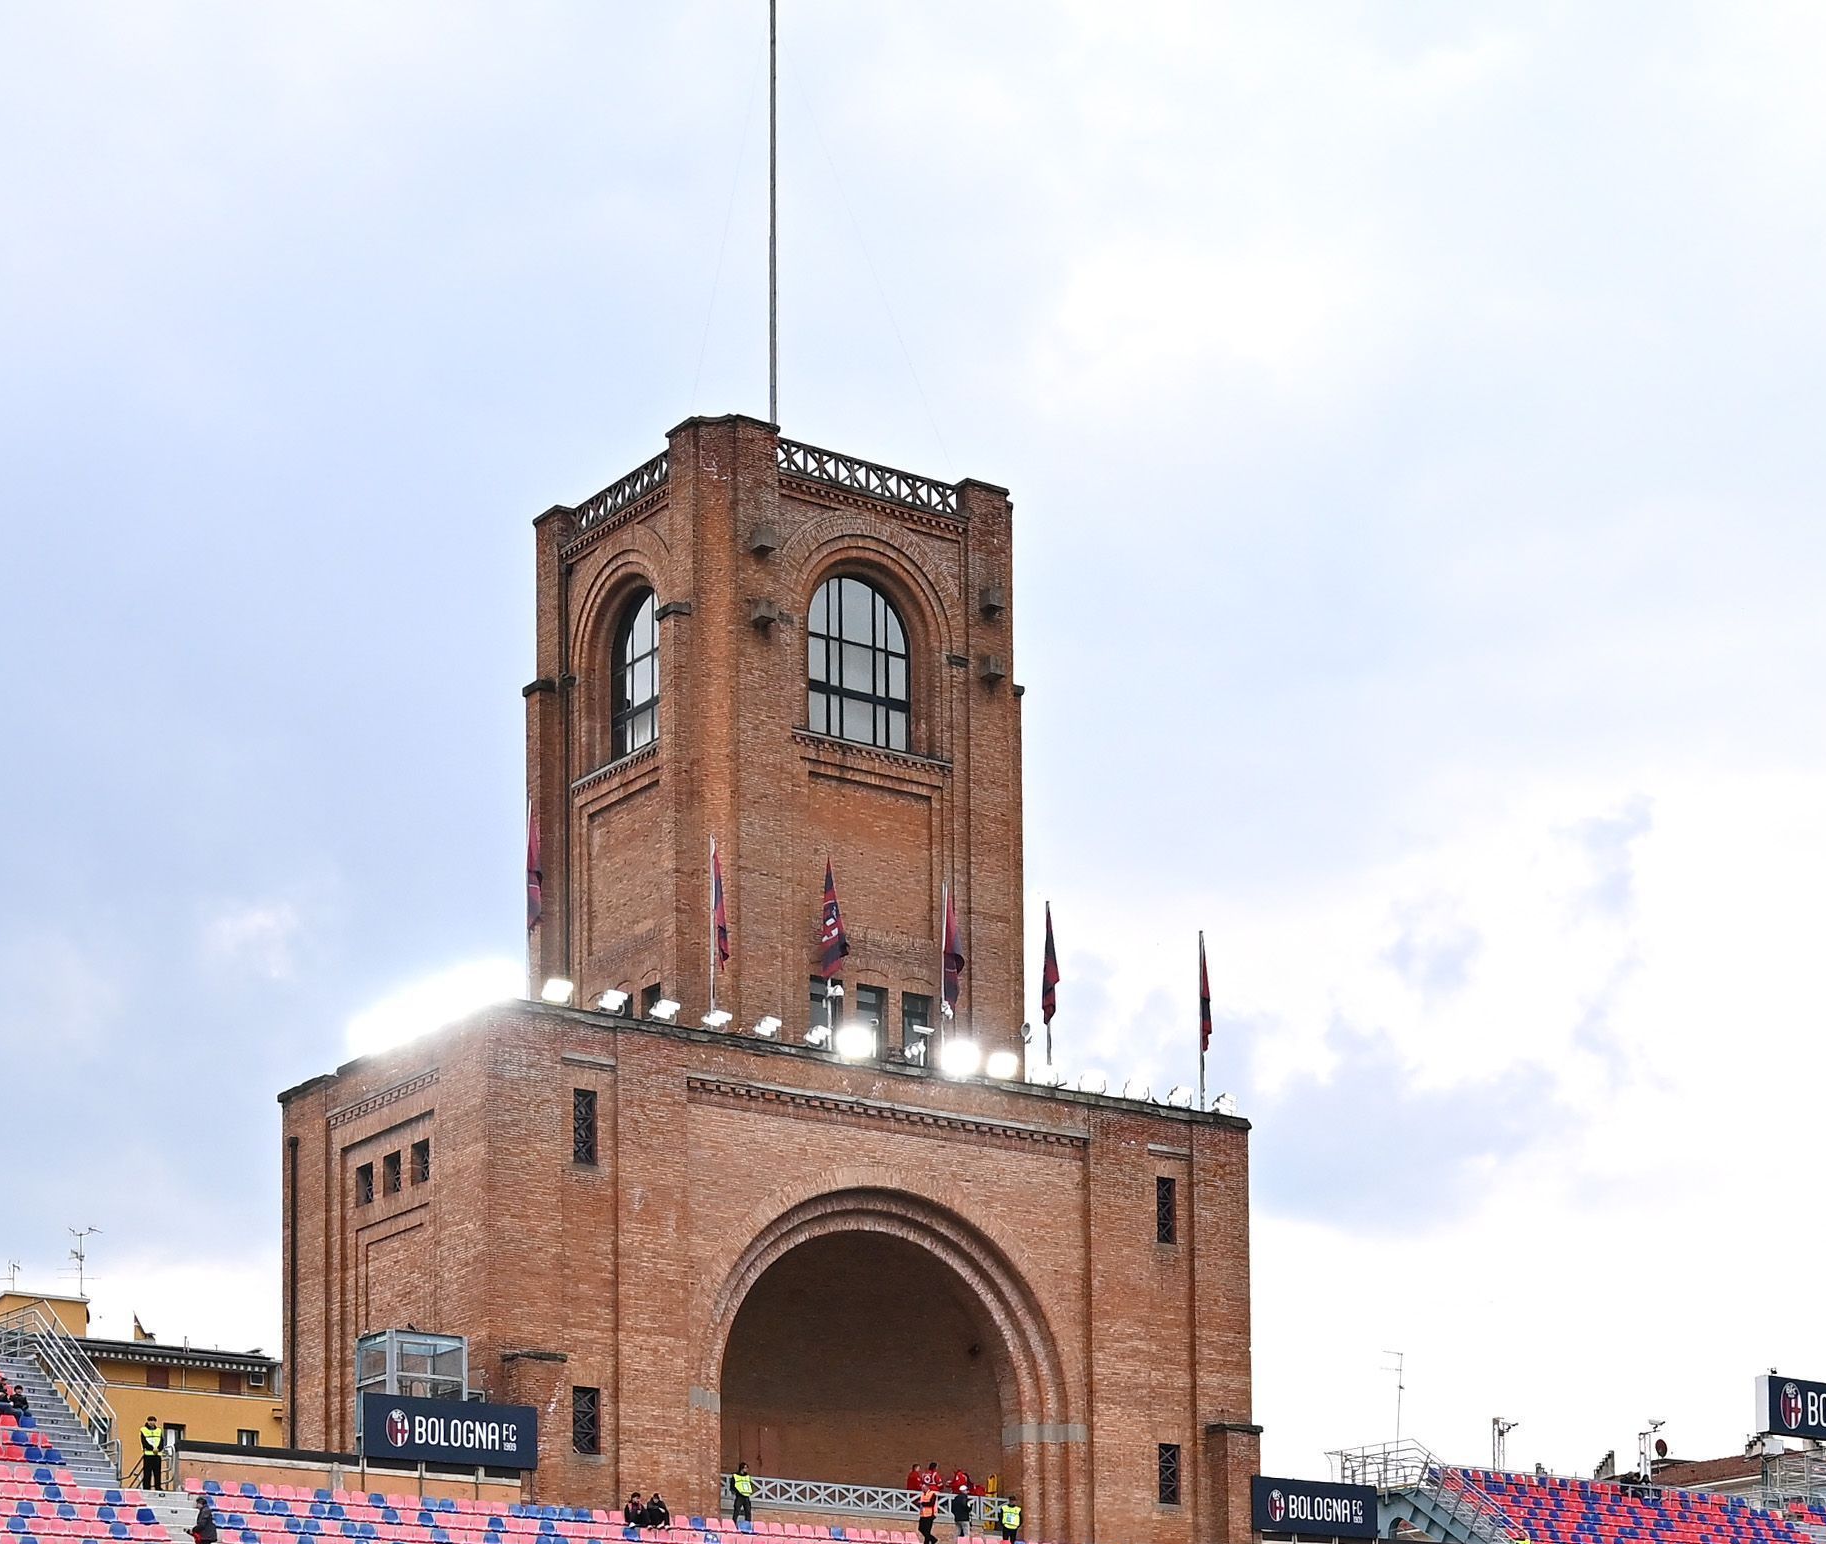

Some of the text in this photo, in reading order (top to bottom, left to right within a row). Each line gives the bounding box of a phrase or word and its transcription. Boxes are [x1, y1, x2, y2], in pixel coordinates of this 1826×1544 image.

[414, 1416, 517, 1450] BOLOGNA FC
[1289, 1495, 1363, 1522] BOLOGNA FC
